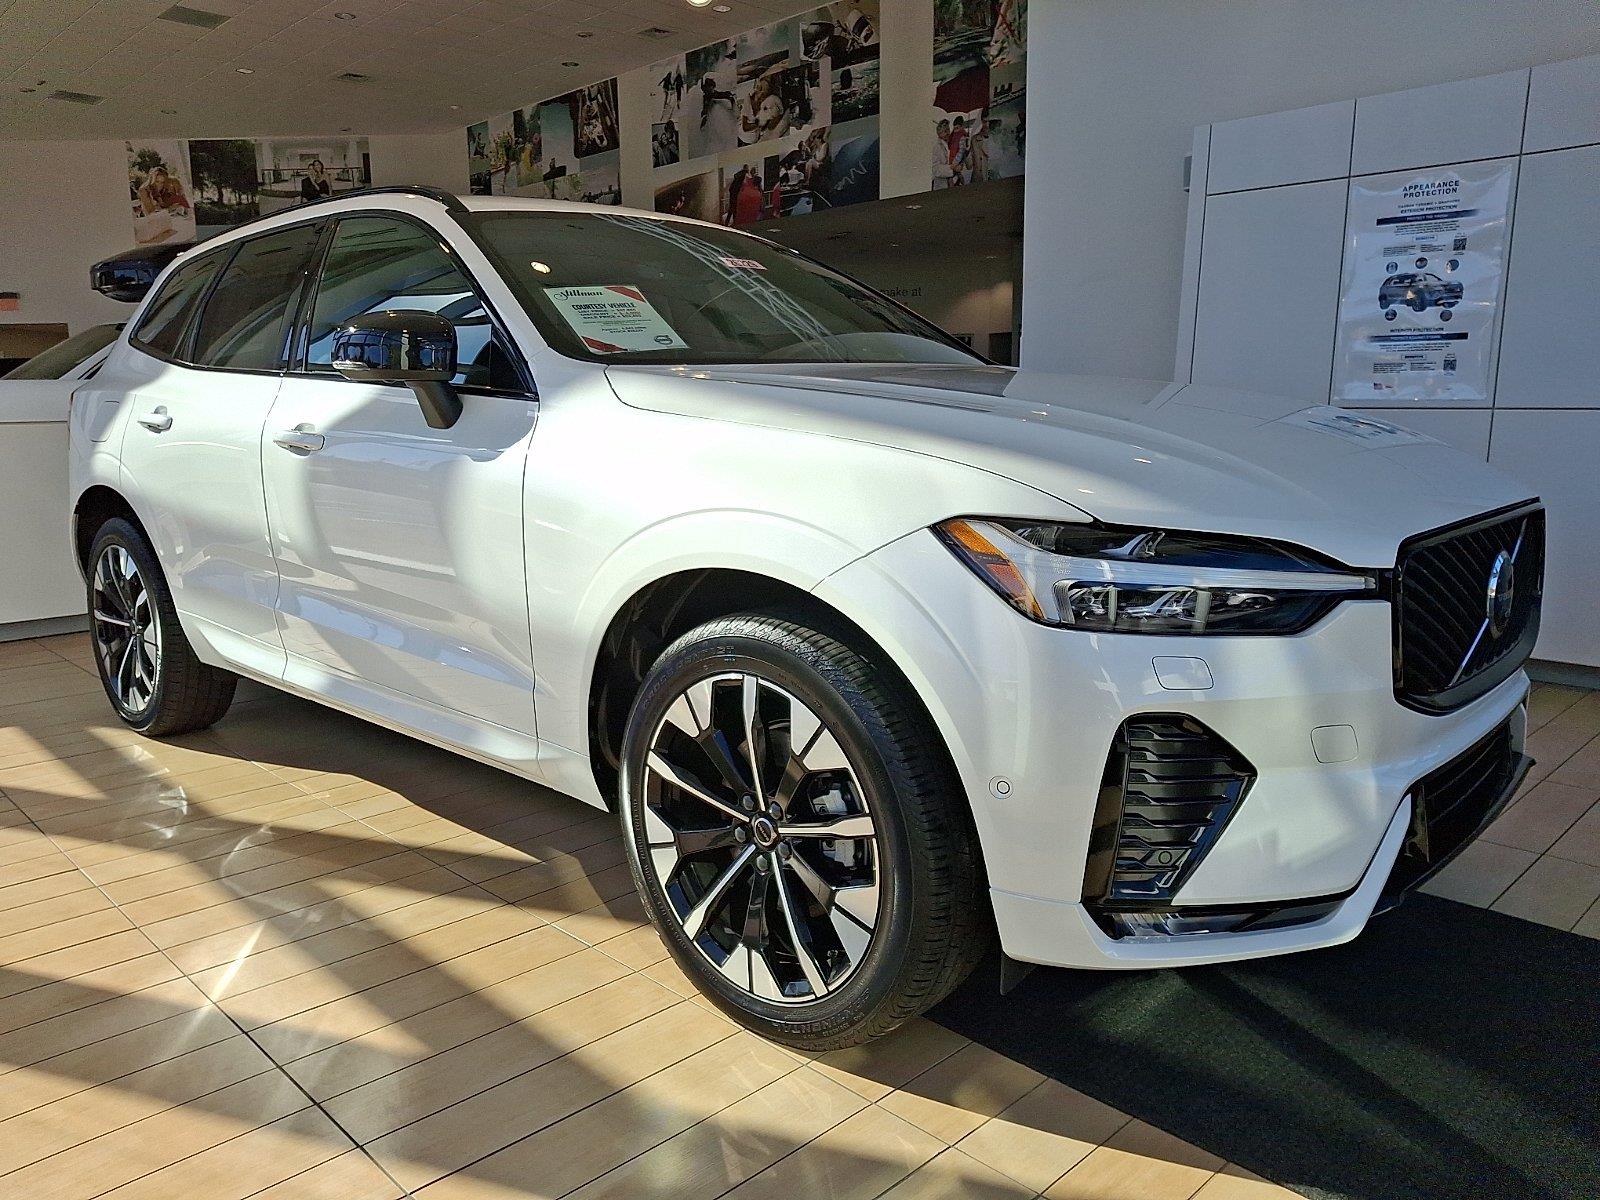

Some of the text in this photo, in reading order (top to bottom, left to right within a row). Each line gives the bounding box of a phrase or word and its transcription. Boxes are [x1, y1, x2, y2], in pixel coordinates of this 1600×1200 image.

[1402, 180, 1460, 192] APPEARANCE
[1403, 187, 1458, 198] PROTECTION
[911, 287, 922, 297] at
